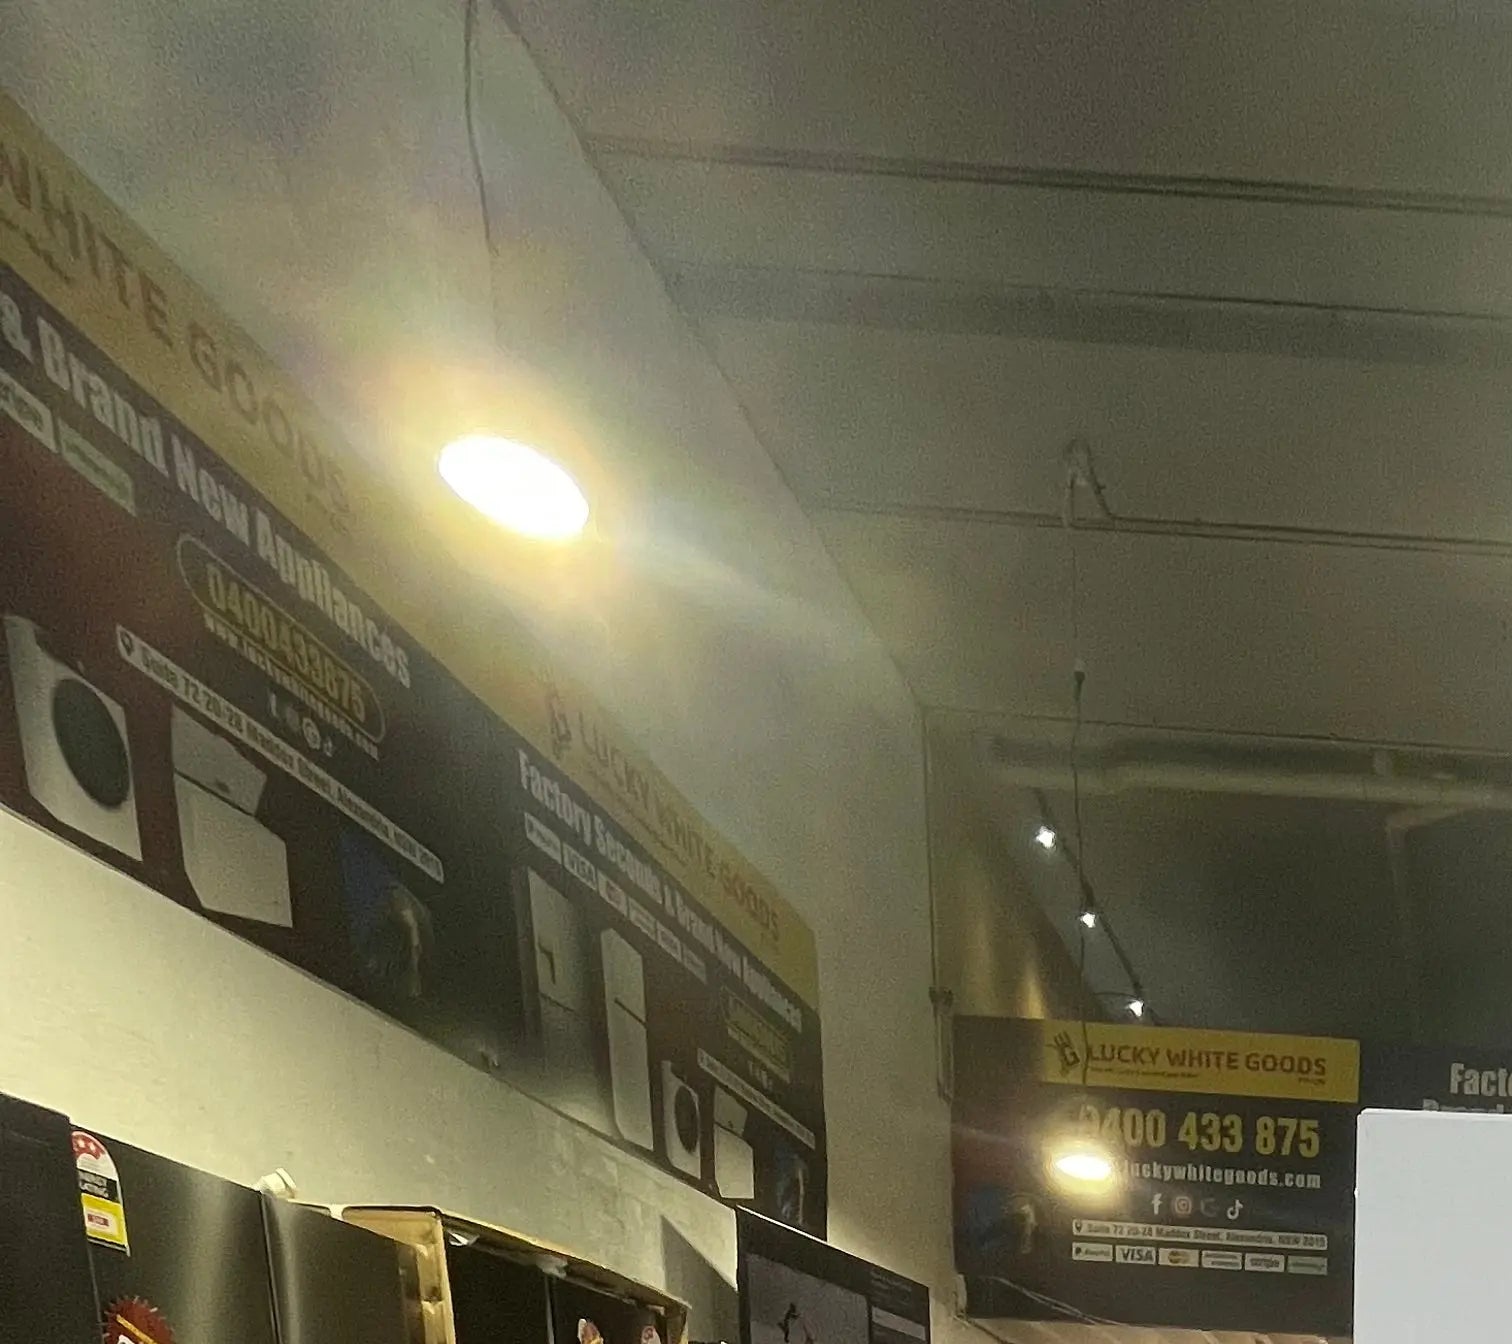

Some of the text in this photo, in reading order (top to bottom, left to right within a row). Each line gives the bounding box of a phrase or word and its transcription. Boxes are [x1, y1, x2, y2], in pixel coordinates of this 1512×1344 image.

[0, 294, 36, 370] &
[36, 317, 169, 478] Brand
[171, 431, 250, 547] New
[255, 506, 411, 689] Appliances
[518, 748, 592, 847] Factory
[1086, 1043, 1327, 1077] LUCKY WHITE GOODS
[1177, 1110, 1244, 1153] 433
[1255, 1115, 1321, 1159] 875
[1122, 1248, 1154, 1263] VISA
